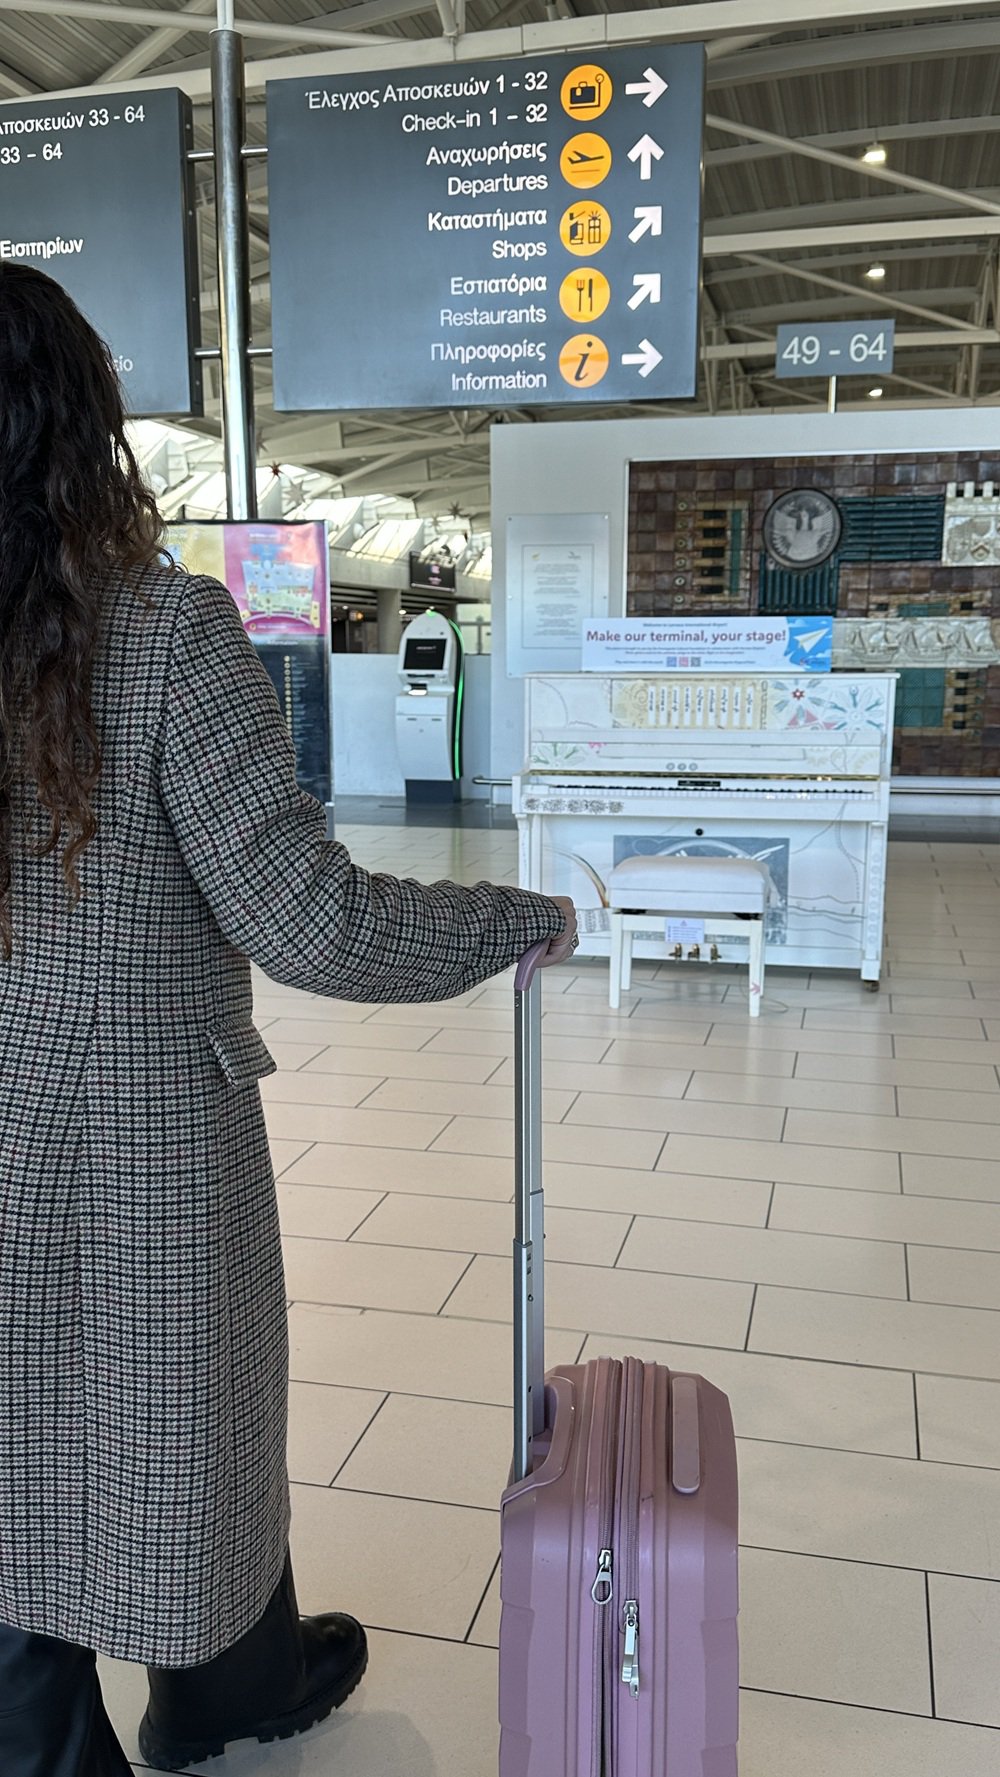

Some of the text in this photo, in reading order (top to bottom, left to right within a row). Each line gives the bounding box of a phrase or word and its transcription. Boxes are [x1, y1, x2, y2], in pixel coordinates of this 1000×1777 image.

[304, 89, 380, 111] Έλεγχος
[382, 77, 490, 103] Αποσκευών
[496, 74, 505, 94] 1
[524, 71, 548, 91] 32
[88, 108, 110, 127] 33
[124, 105, 146, 124] 64
[401, 110, 481, 133] Check-in
[488, 107, 498, 126] 1
[525, 103, 548, 123] 32
[0, 146, 21, 165] 33
[42, 142, 63, 161] 64
[425, 140, 548, 168] Αναχωρήσεις
[447, 173, 549, 198] Departures
[428, 207, 547, 232] Καταστήματα
[492, 240, 548, 261] Shops
[450, 273, 547, 297] Εστιατόρια
[440, 304, 547, 328] Restaurants
[430, 338, 547, 365] Πληροφορίες
[781, 334, 821, 366] 49
[849, 332, 887, 362] 64
[451, 370, 547, 392] Information
[586, 630, 621, 642] Make
[624, 633, 647, 642] our
[649, 630, 708, 643] terminal,
[711, 632, 743, 645] your
[746, 630, 787, 645] stage!
